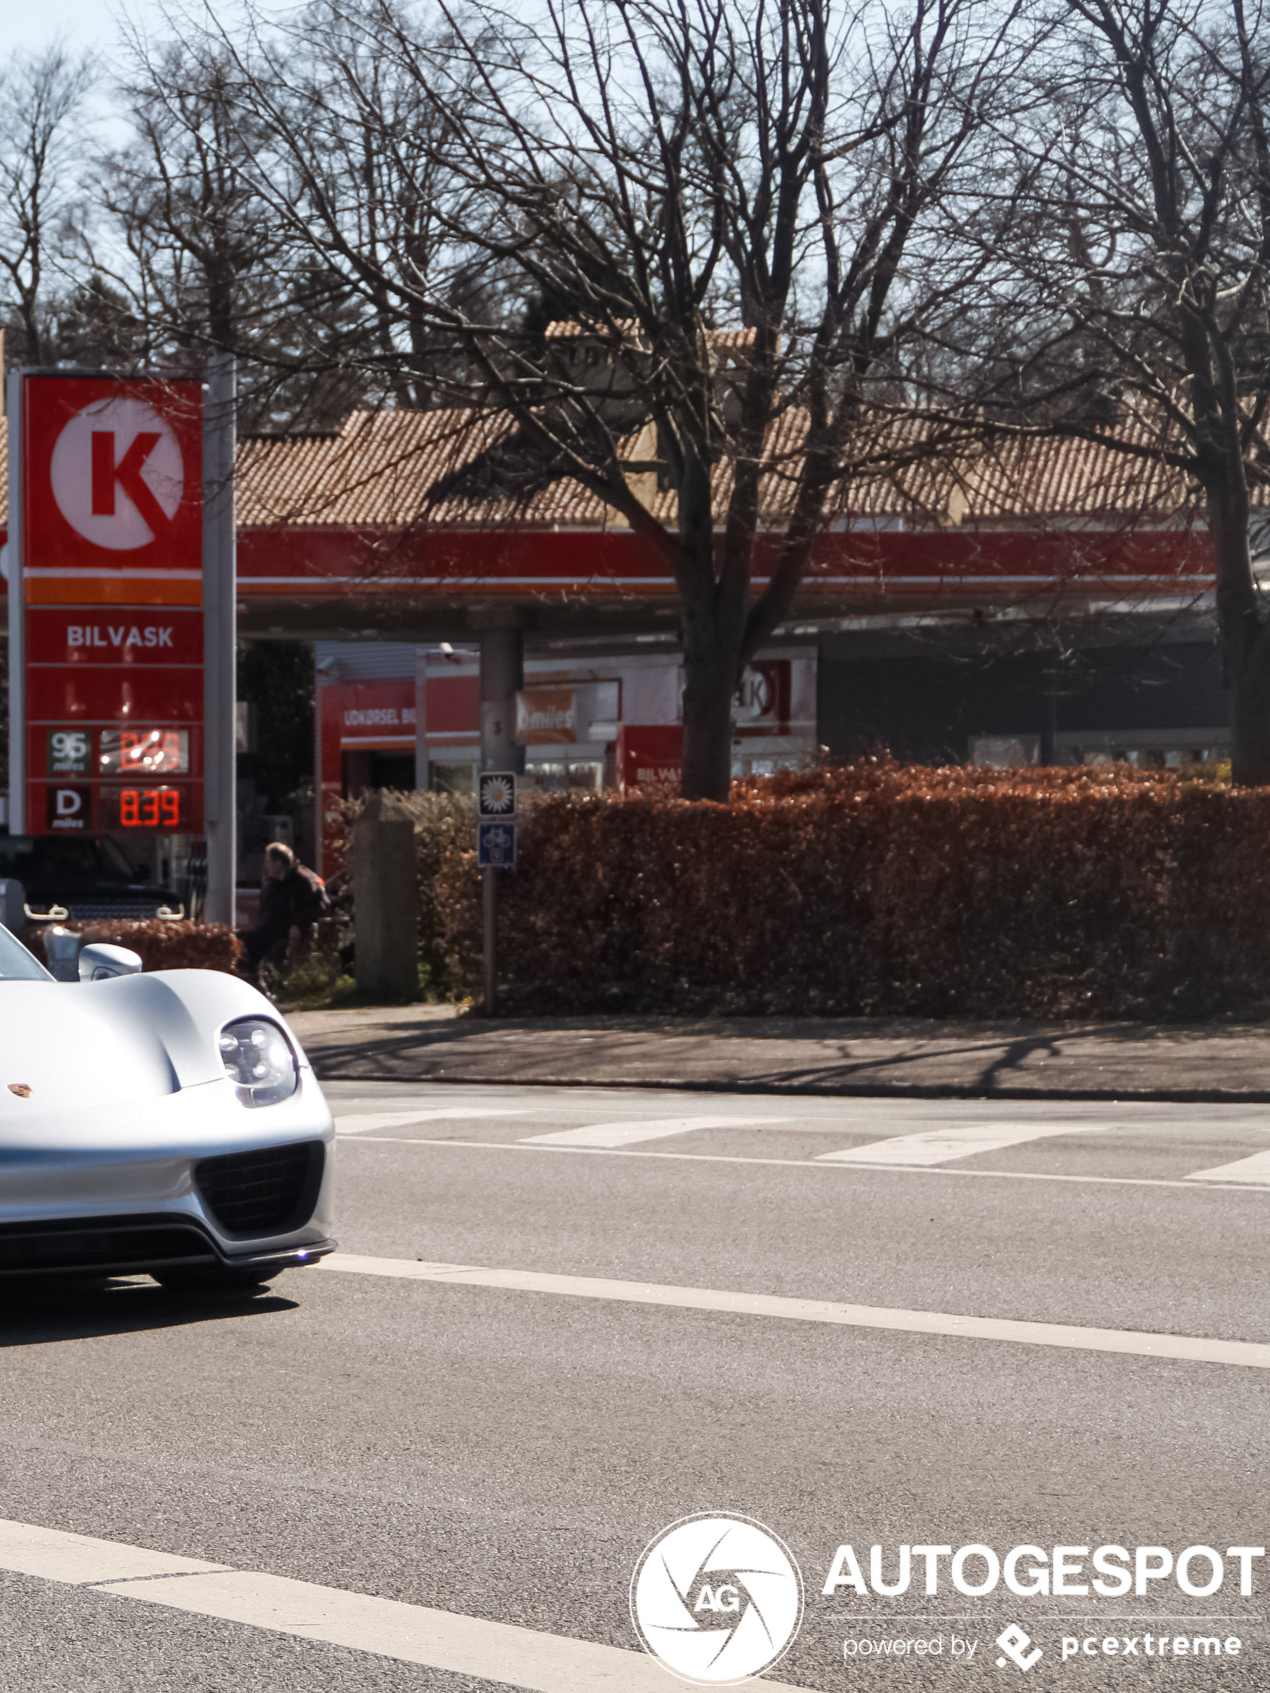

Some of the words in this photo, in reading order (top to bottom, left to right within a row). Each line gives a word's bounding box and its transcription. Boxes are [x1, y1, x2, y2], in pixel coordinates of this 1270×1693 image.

[91, 431, 173, 541] K
[67, 626, 173, 647] BILVASK
[51, 732, 87, 758] 95
[56, 789, 82, 815] D
[52, 817, 85, 829] miles
